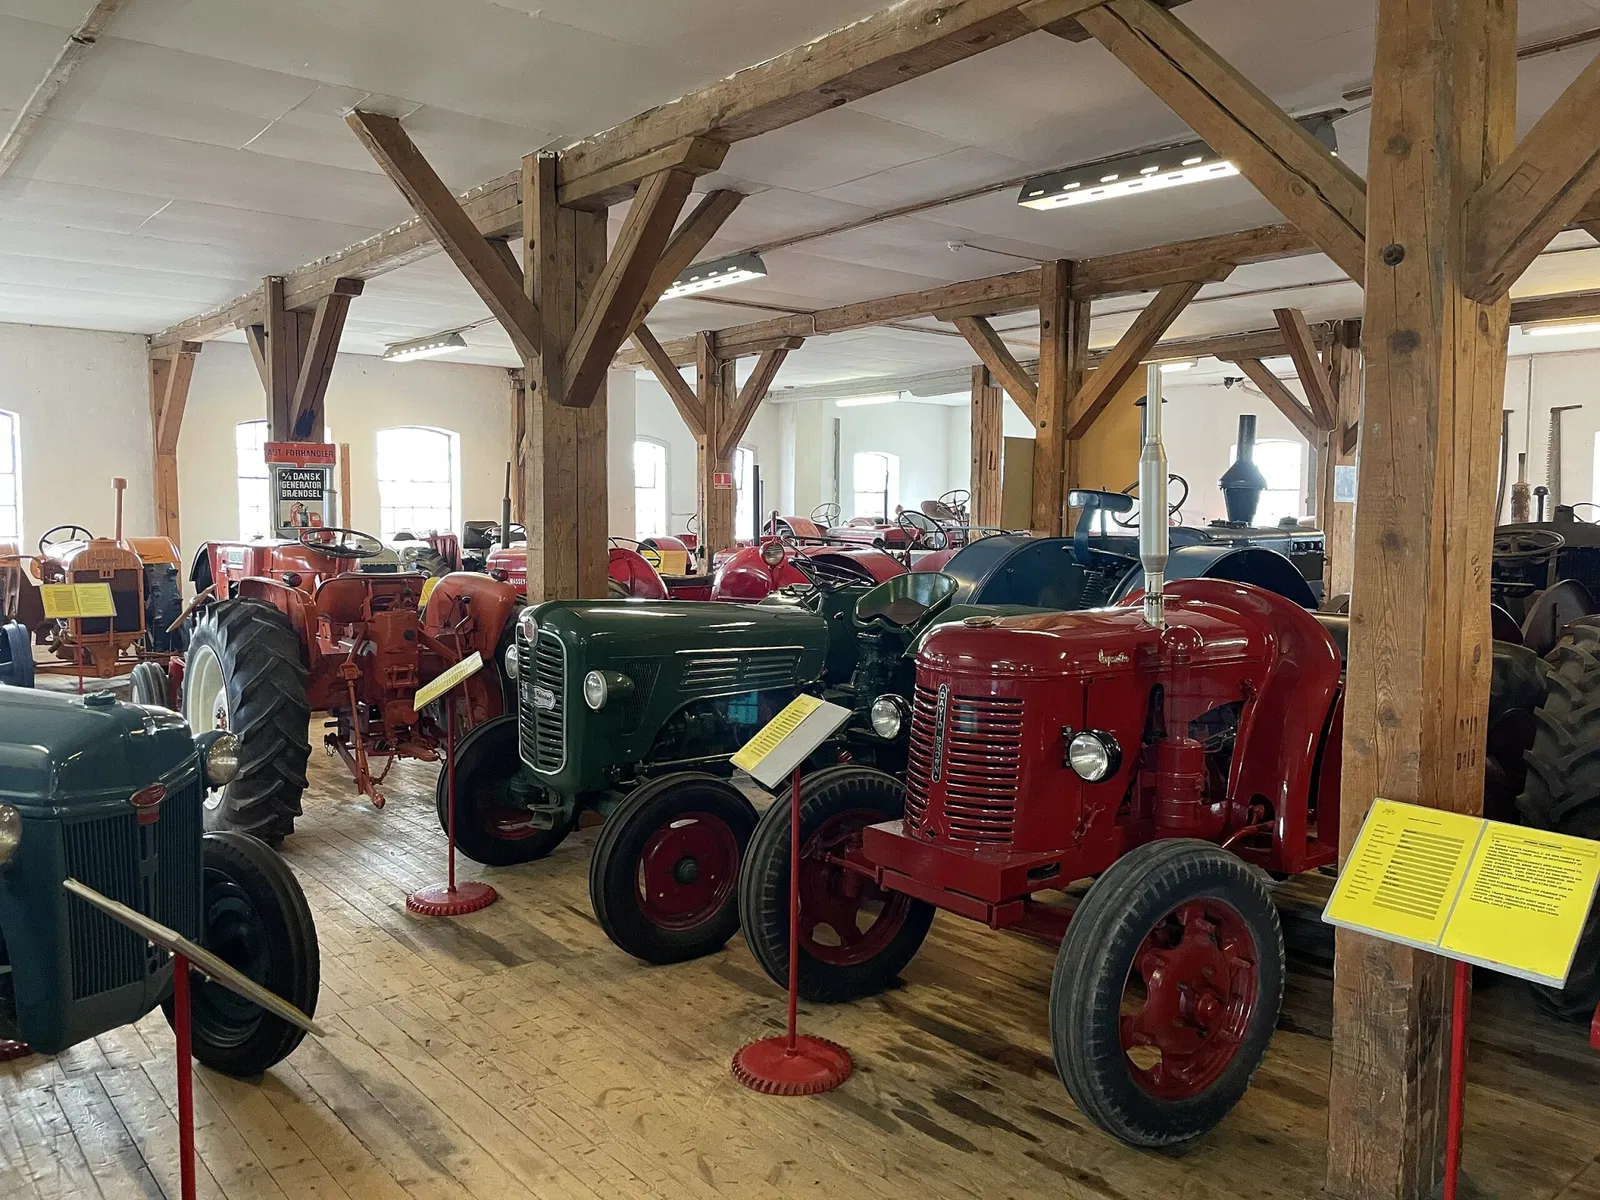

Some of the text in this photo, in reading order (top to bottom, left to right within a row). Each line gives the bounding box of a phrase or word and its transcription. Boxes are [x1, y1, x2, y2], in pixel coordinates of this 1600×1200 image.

[285, 449, 334, 458] FORHANDLER
[293, 472, 321, 481] DANSK
[282, 481, 322, 489] GENERATOR
[282, 490, 322, 498] BRÆNDSEL
[938, 692, 946, 729] DAVID
